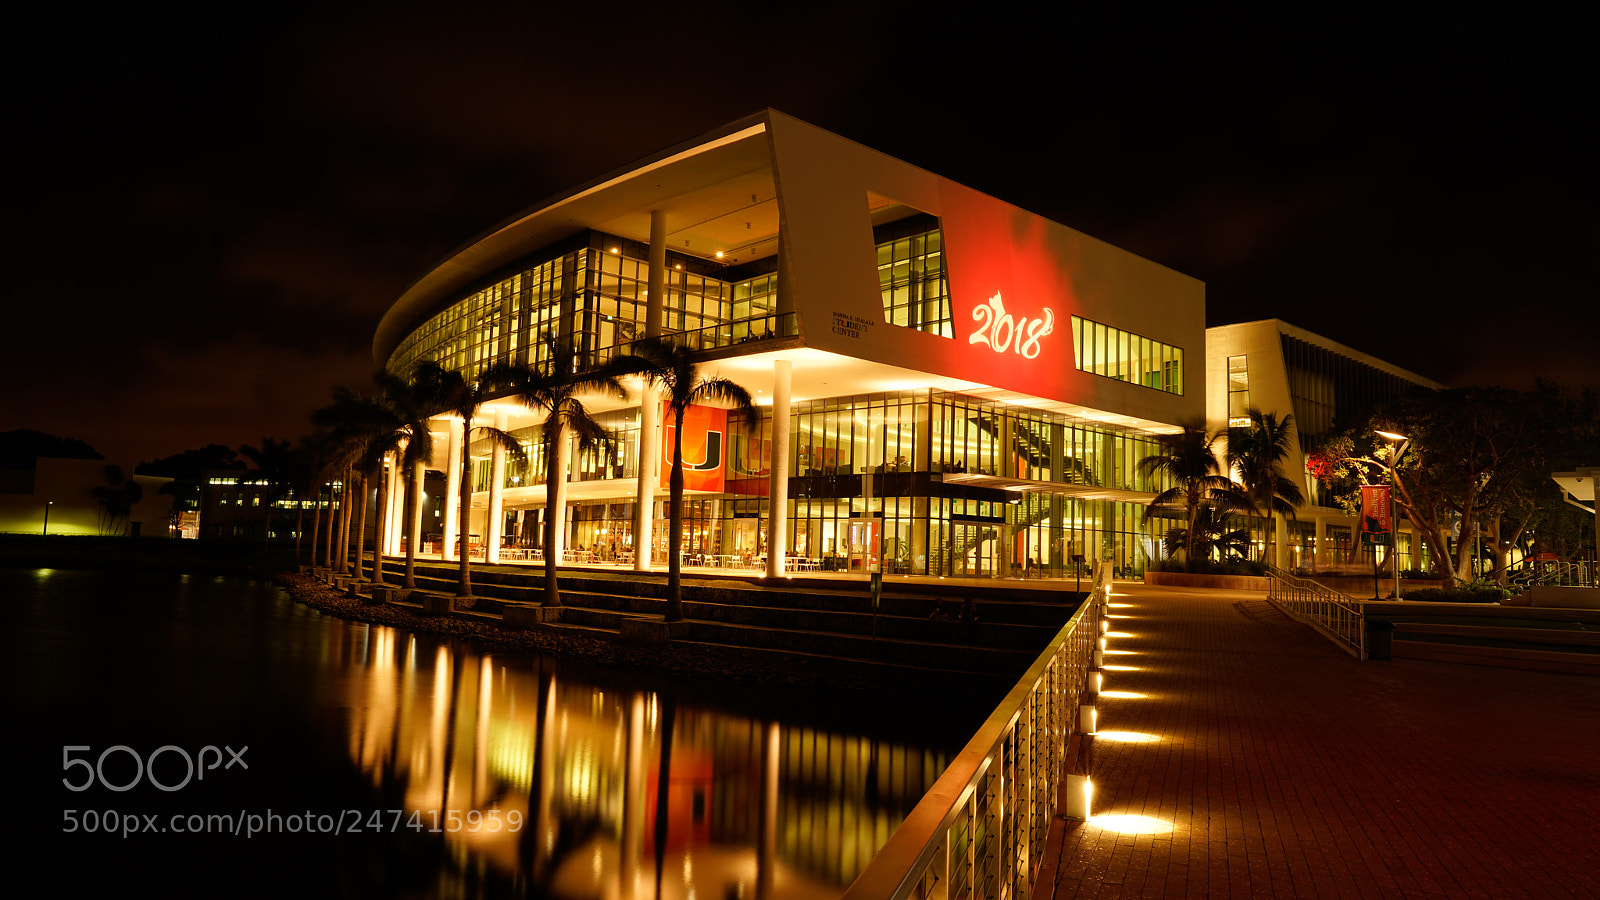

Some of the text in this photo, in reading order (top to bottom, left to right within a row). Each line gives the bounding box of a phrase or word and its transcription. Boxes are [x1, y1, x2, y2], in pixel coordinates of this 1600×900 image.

[832, 326, 860, 339] CENTER
[968, 290, 1055, 360] 2018
[665, 425, 722, 472] U
